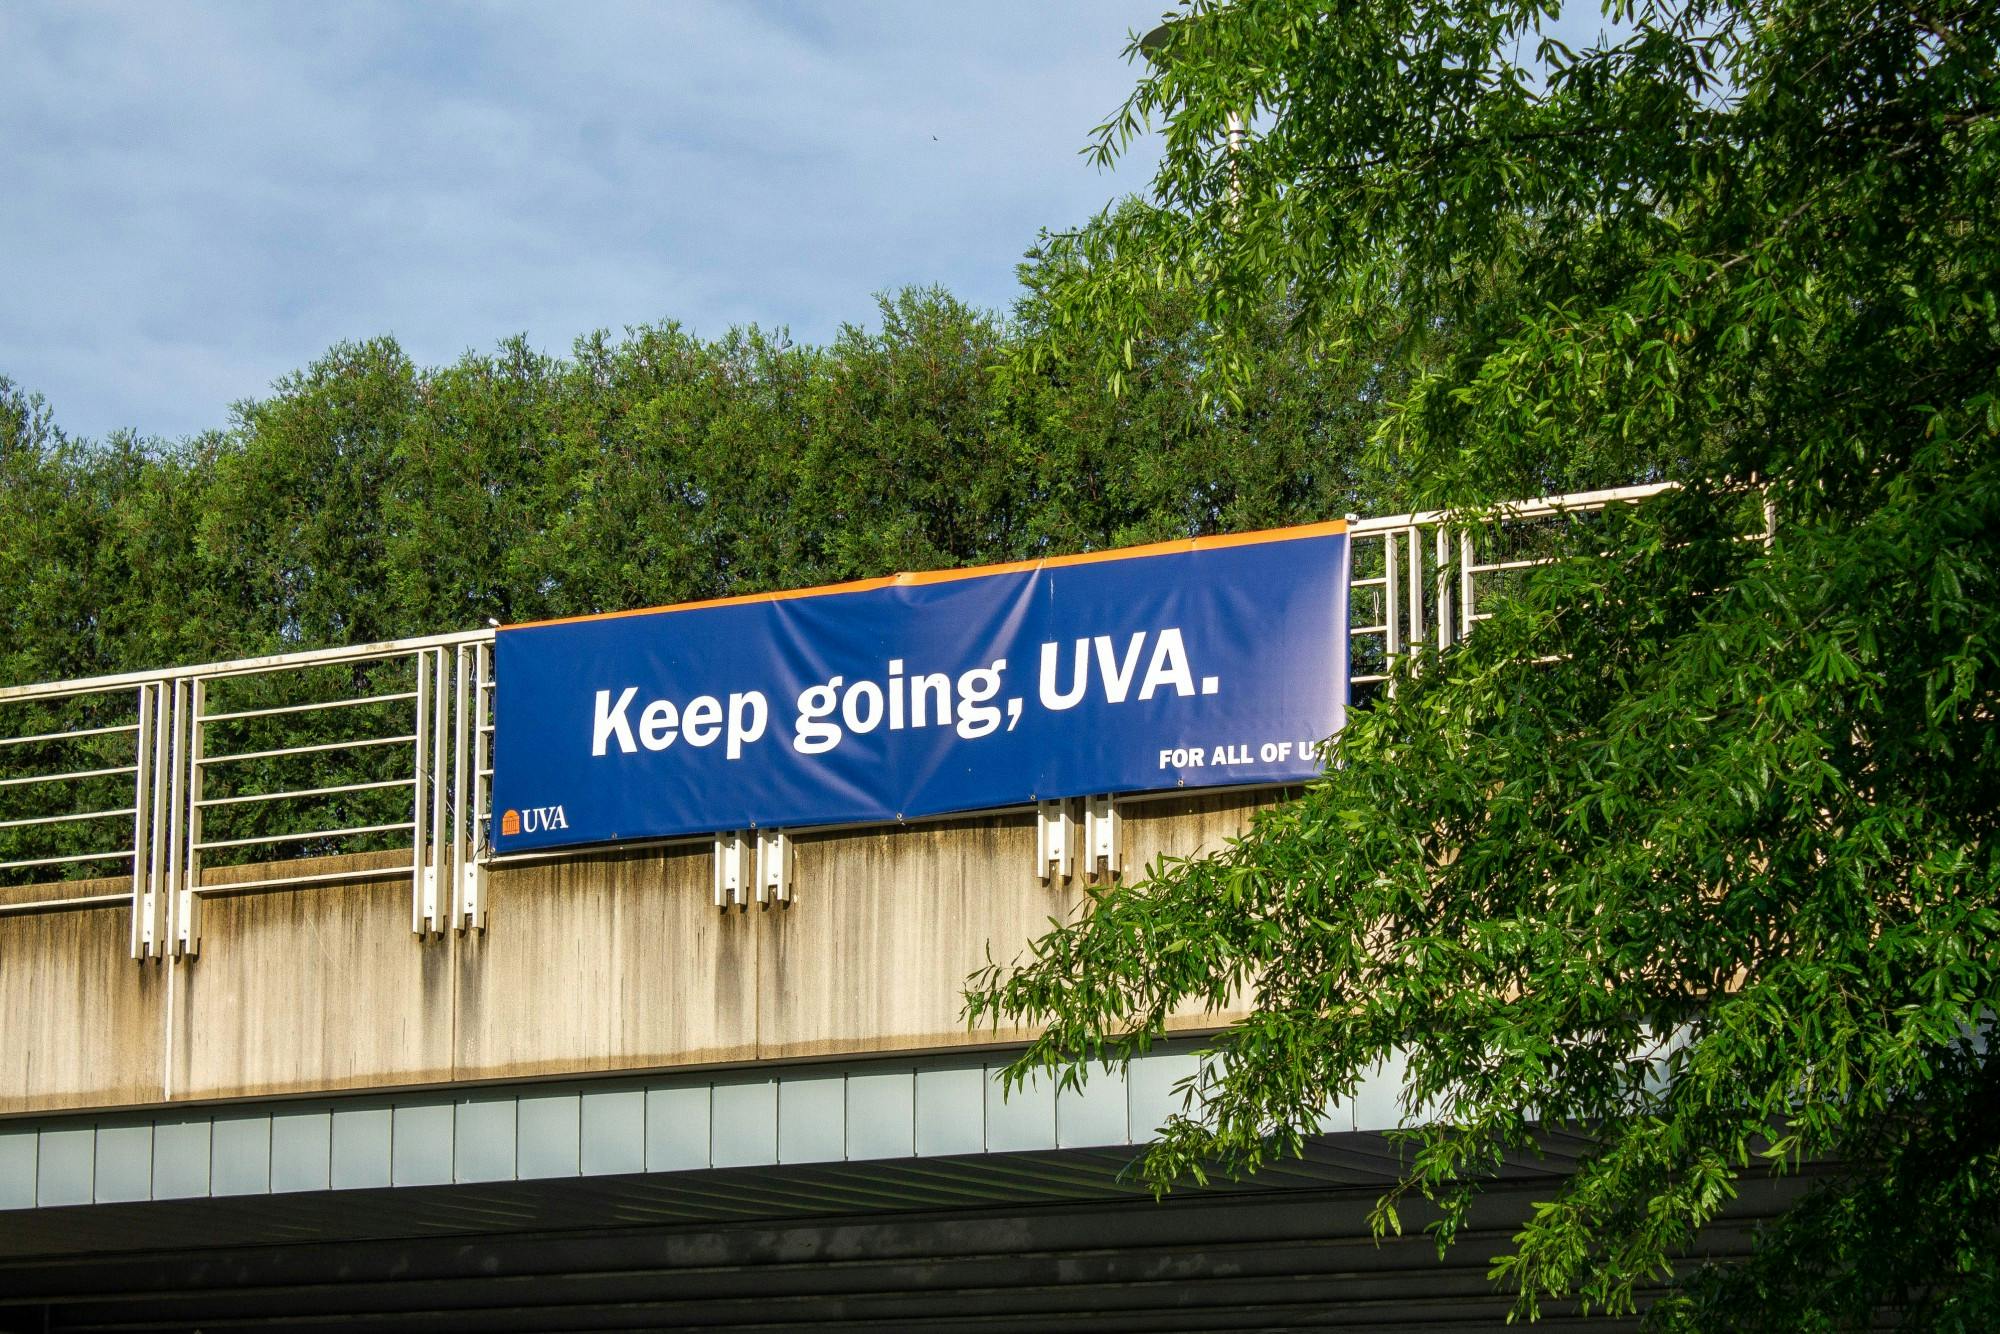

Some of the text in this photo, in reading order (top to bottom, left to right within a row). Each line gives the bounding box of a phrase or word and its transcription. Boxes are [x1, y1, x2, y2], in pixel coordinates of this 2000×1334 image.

[591, 627, 1219, 760] Keep going, UVA.
[1159, 747, 1205, 770] FOR
[1210, 744, 1254, 766] ALL
[1260, 741, 1293, 763] OF
[522, 805, 569, 833] UVA
